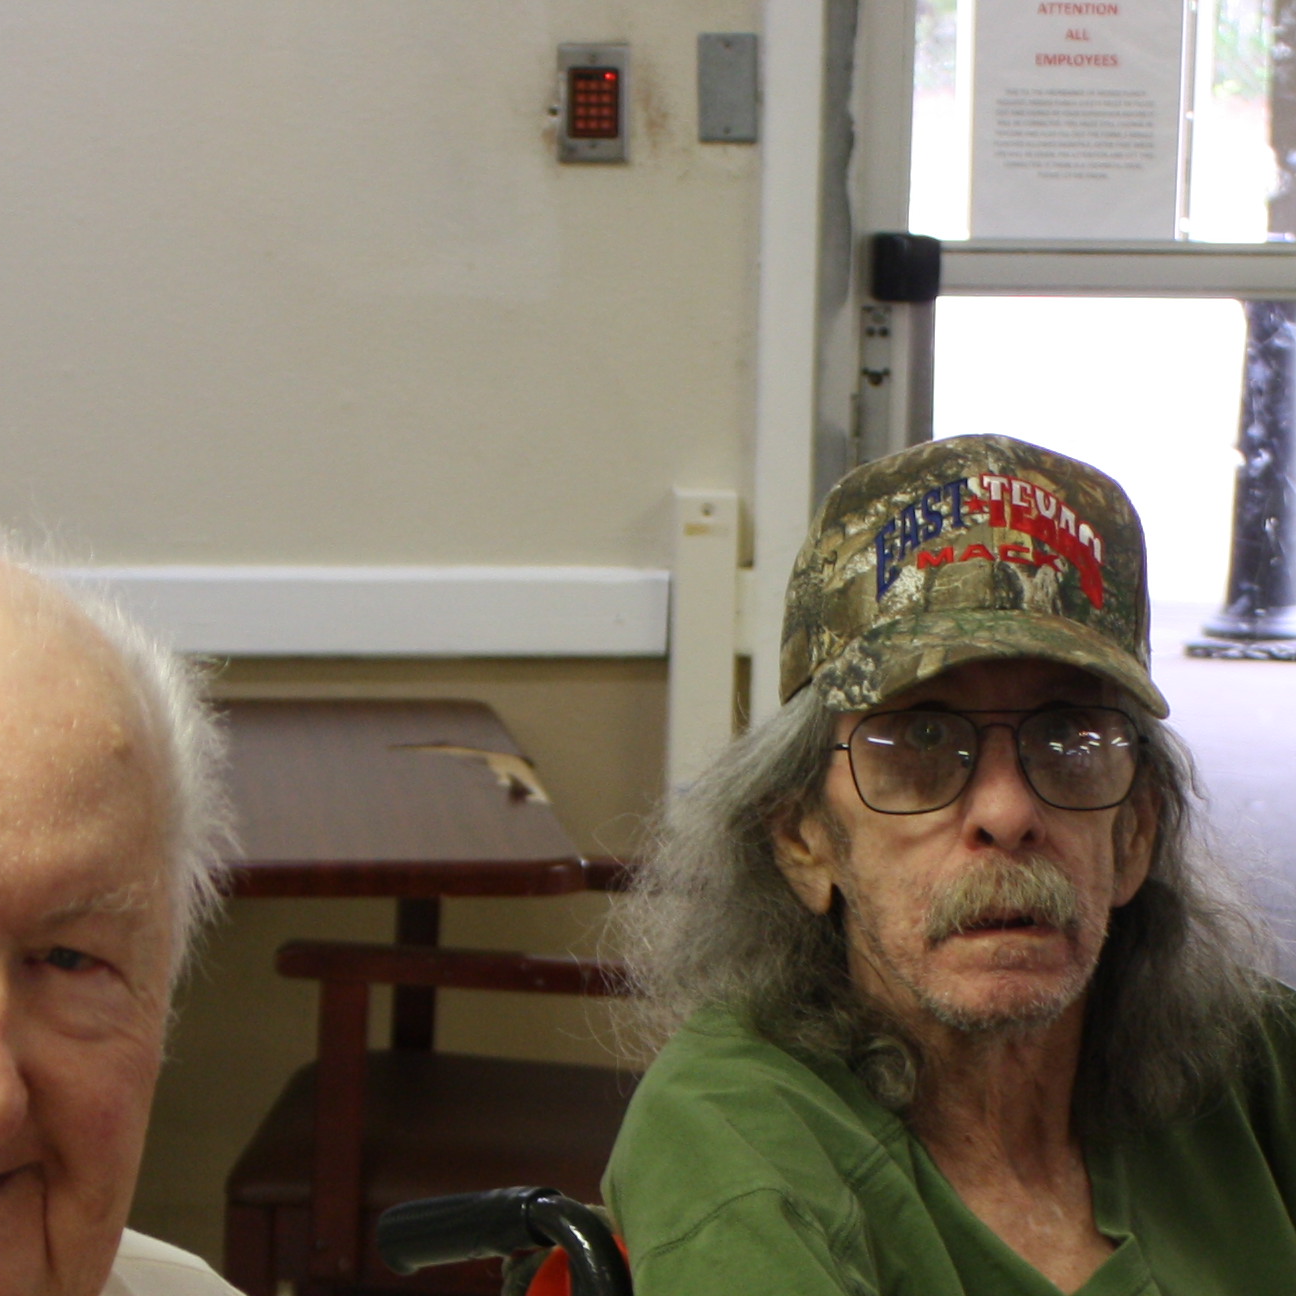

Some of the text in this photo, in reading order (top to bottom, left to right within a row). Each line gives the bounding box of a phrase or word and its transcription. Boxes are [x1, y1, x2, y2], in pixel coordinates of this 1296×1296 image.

[1037, 2, 1119, 16] ATTENTION
[1065, 28, 1090, 41] ALL
[1035, 53, 1119, 67] EMPLOYEES
[874, 477, 968, 602] EAST
[916, 543, 1066, 573] MACK
